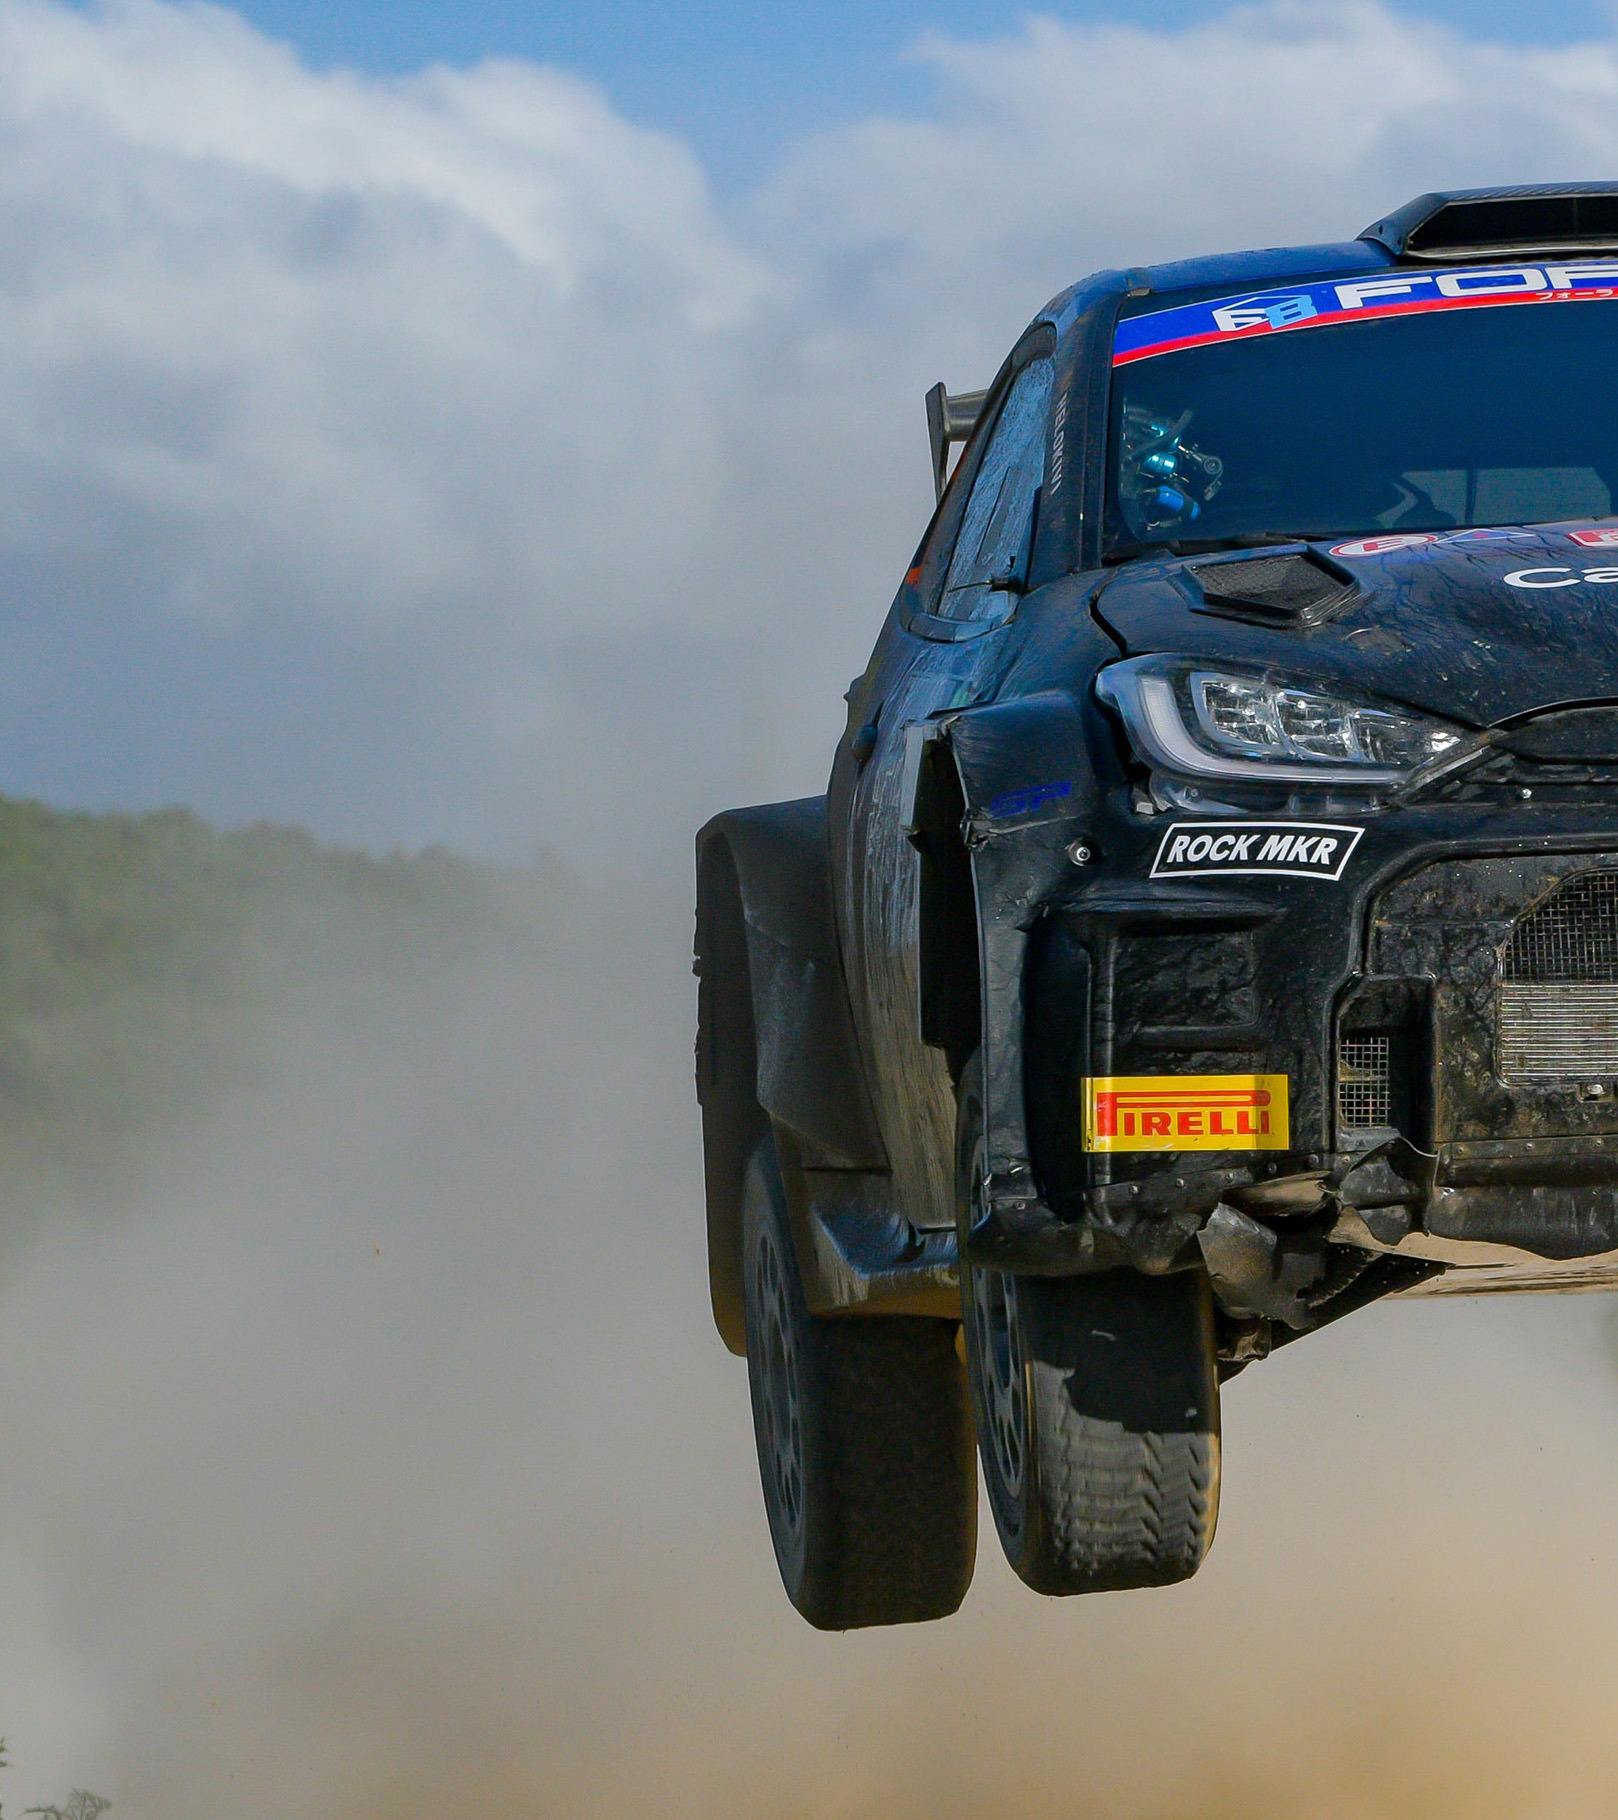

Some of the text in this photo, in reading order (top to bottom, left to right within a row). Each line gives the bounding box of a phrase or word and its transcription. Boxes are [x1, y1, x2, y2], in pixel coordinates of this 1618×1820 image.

[1166, 835, 1338, 865] ROCK MKR
[1096, 1089, 1272, 1137] PIRELLI
